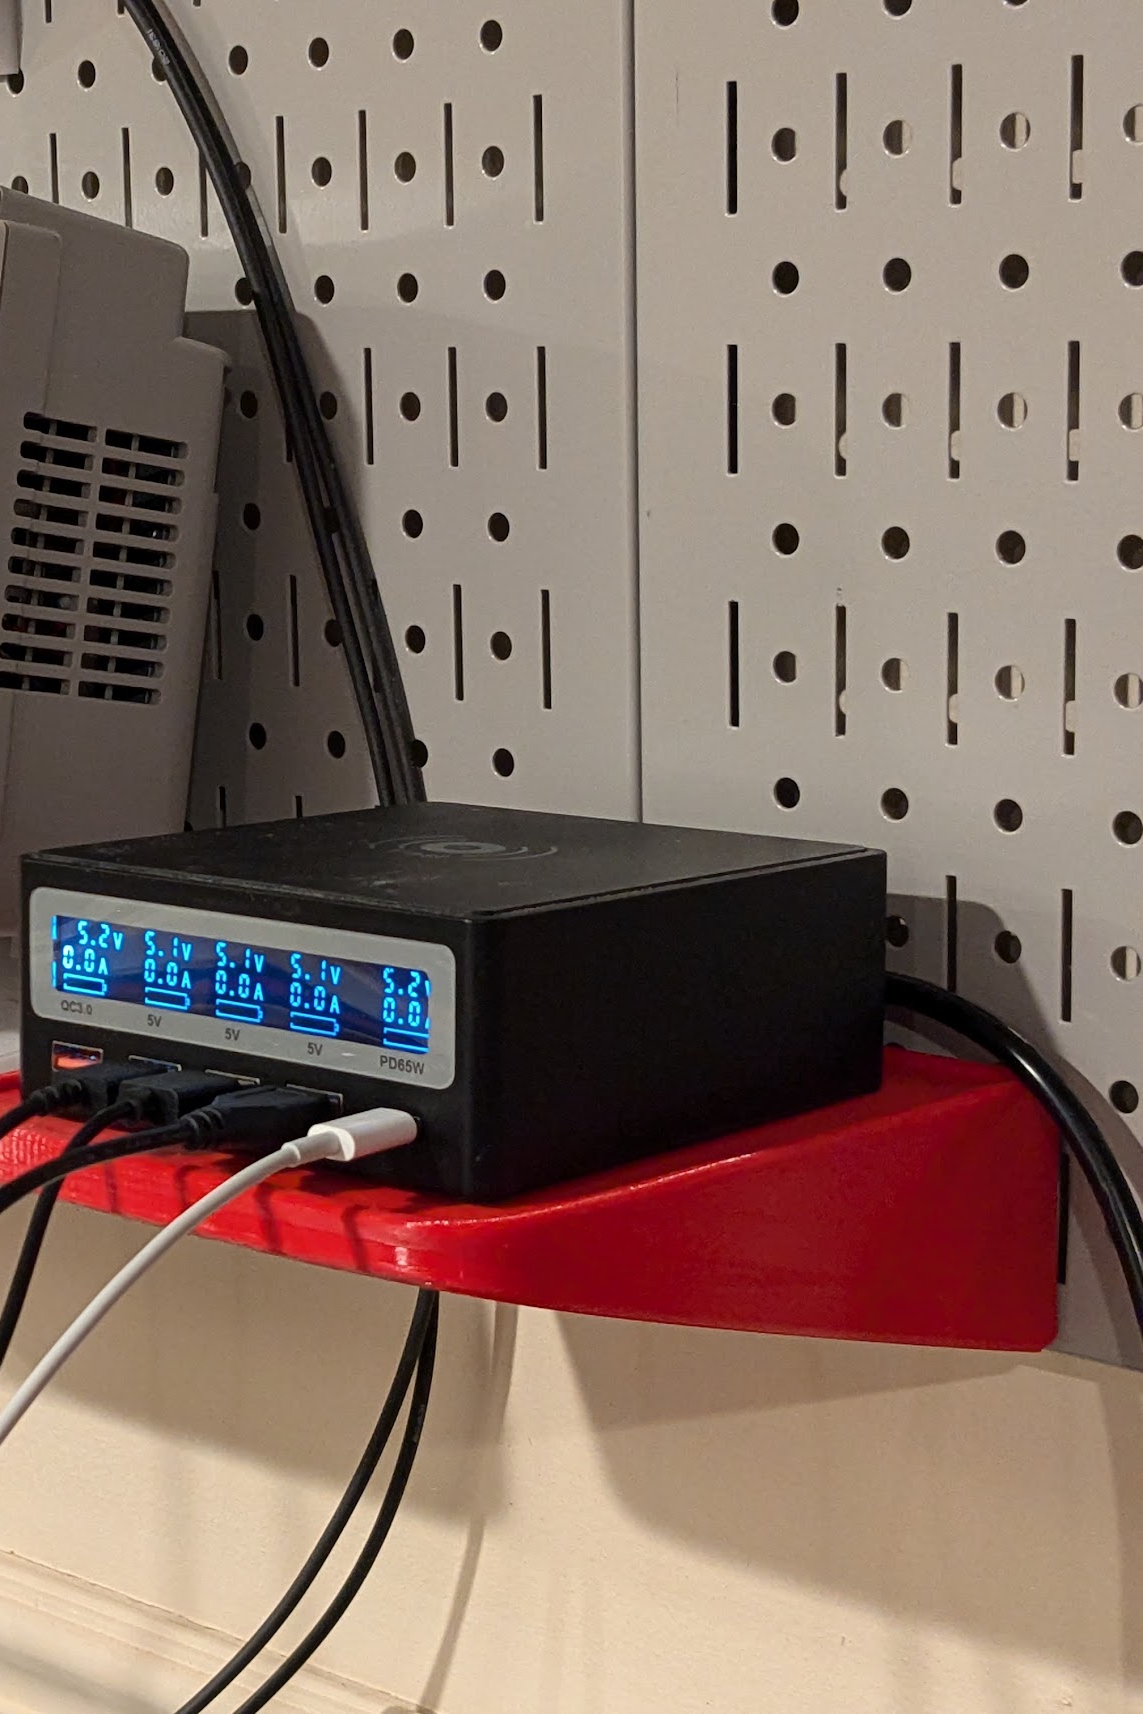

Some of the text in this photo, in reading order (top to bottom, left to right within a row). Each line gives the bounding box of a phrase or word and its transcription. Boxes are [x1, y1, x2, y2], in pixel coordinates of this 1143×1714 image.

[77, 919, 124, 951] 5.2V
[144, 930, 192, 961] 5.1V
[216, 941, 265, 973] 5.1V
[290, 952, 341, 985] 5.1V
[62, 944, 109, 976] 0.0A
[144, 958, 192, 990] 0.0A
[215, 969, 264, 1002] 0.0A
[289, 981, 340, 1014] 0.0A
[60, 999, 93, 1016] QC3.0
[147, 1014, 162, 1028] 5V
[225, 1027, 240, 1041] 5V
[307, 1042, 323, 1056] 5V
[379, 1055, 425, 1075] PD65W
